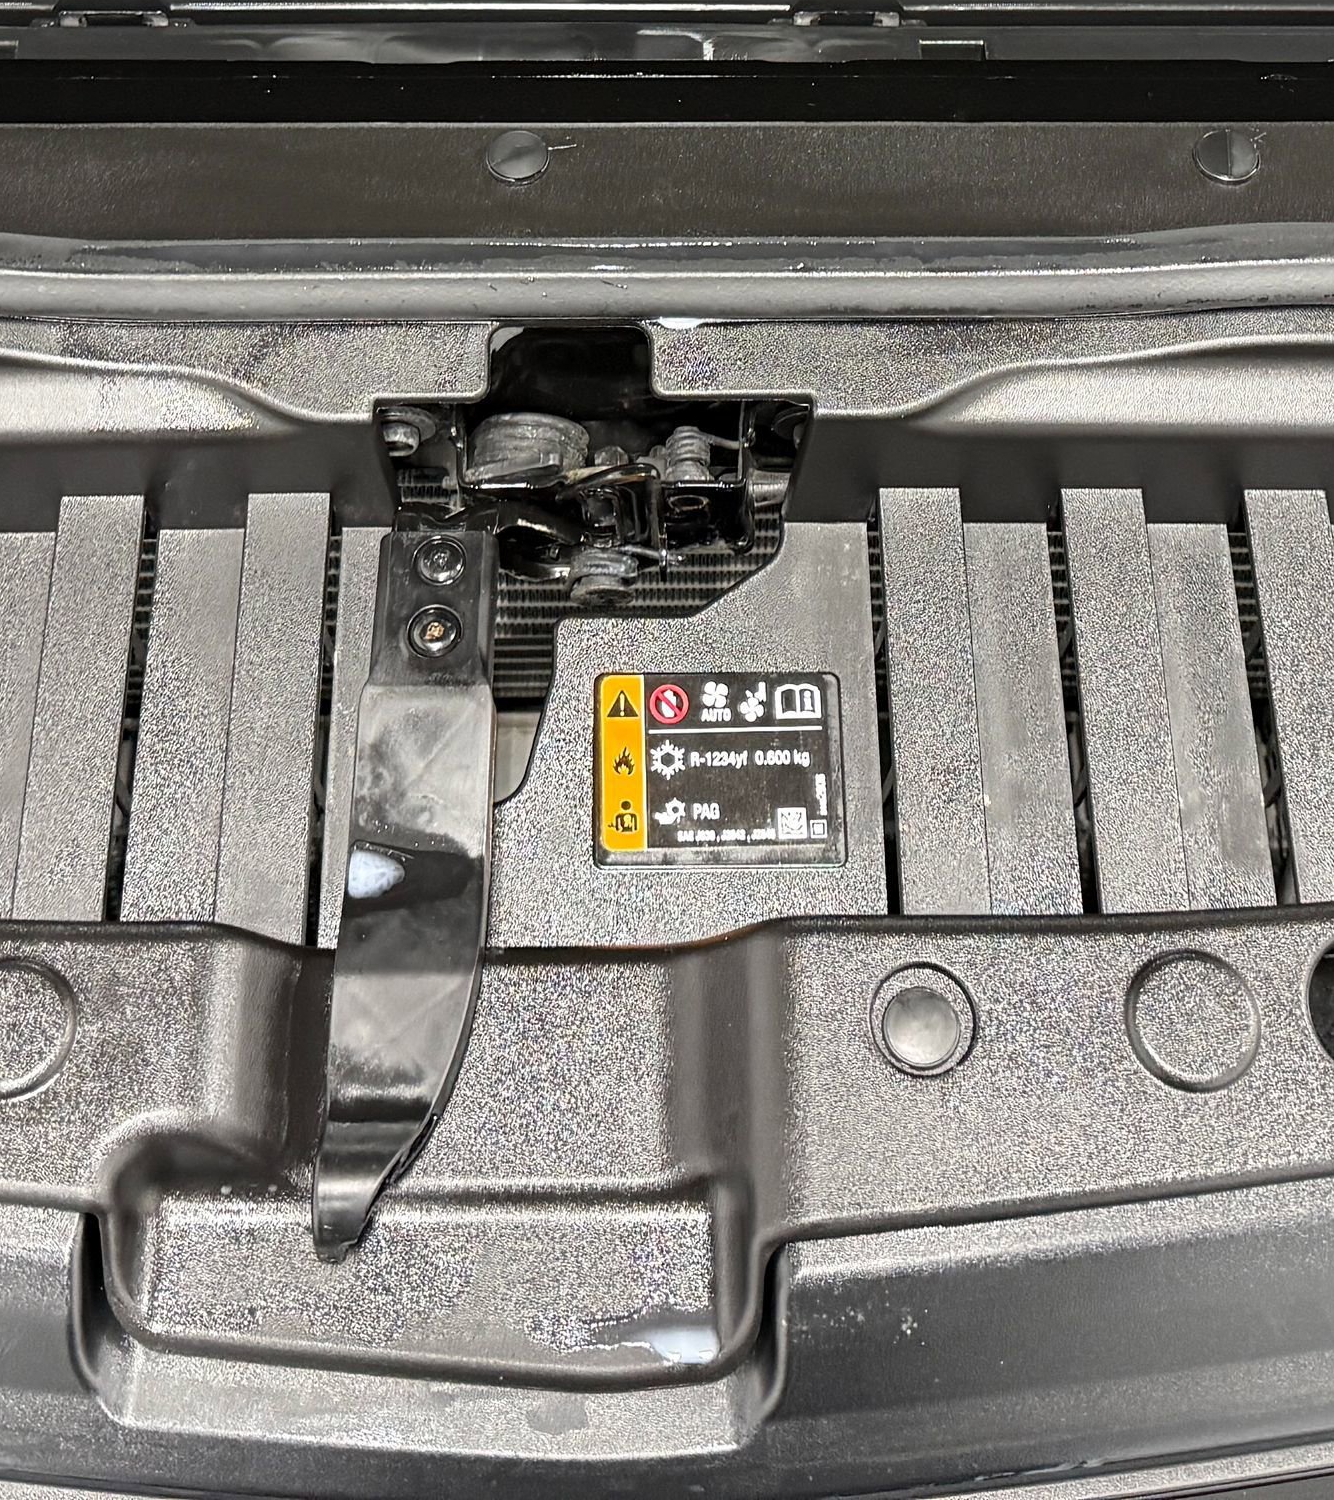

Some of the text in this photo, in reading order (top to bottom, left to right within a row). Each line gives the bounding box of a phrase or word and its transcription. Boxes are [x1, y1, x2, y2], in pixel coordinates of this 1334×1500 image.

[701, 708, 732, 722] AUTO
[690, 750, 748, 769] R-1234yf
[794, 748, 811, 768] kg
[693, 803, 720, 820] PAG
